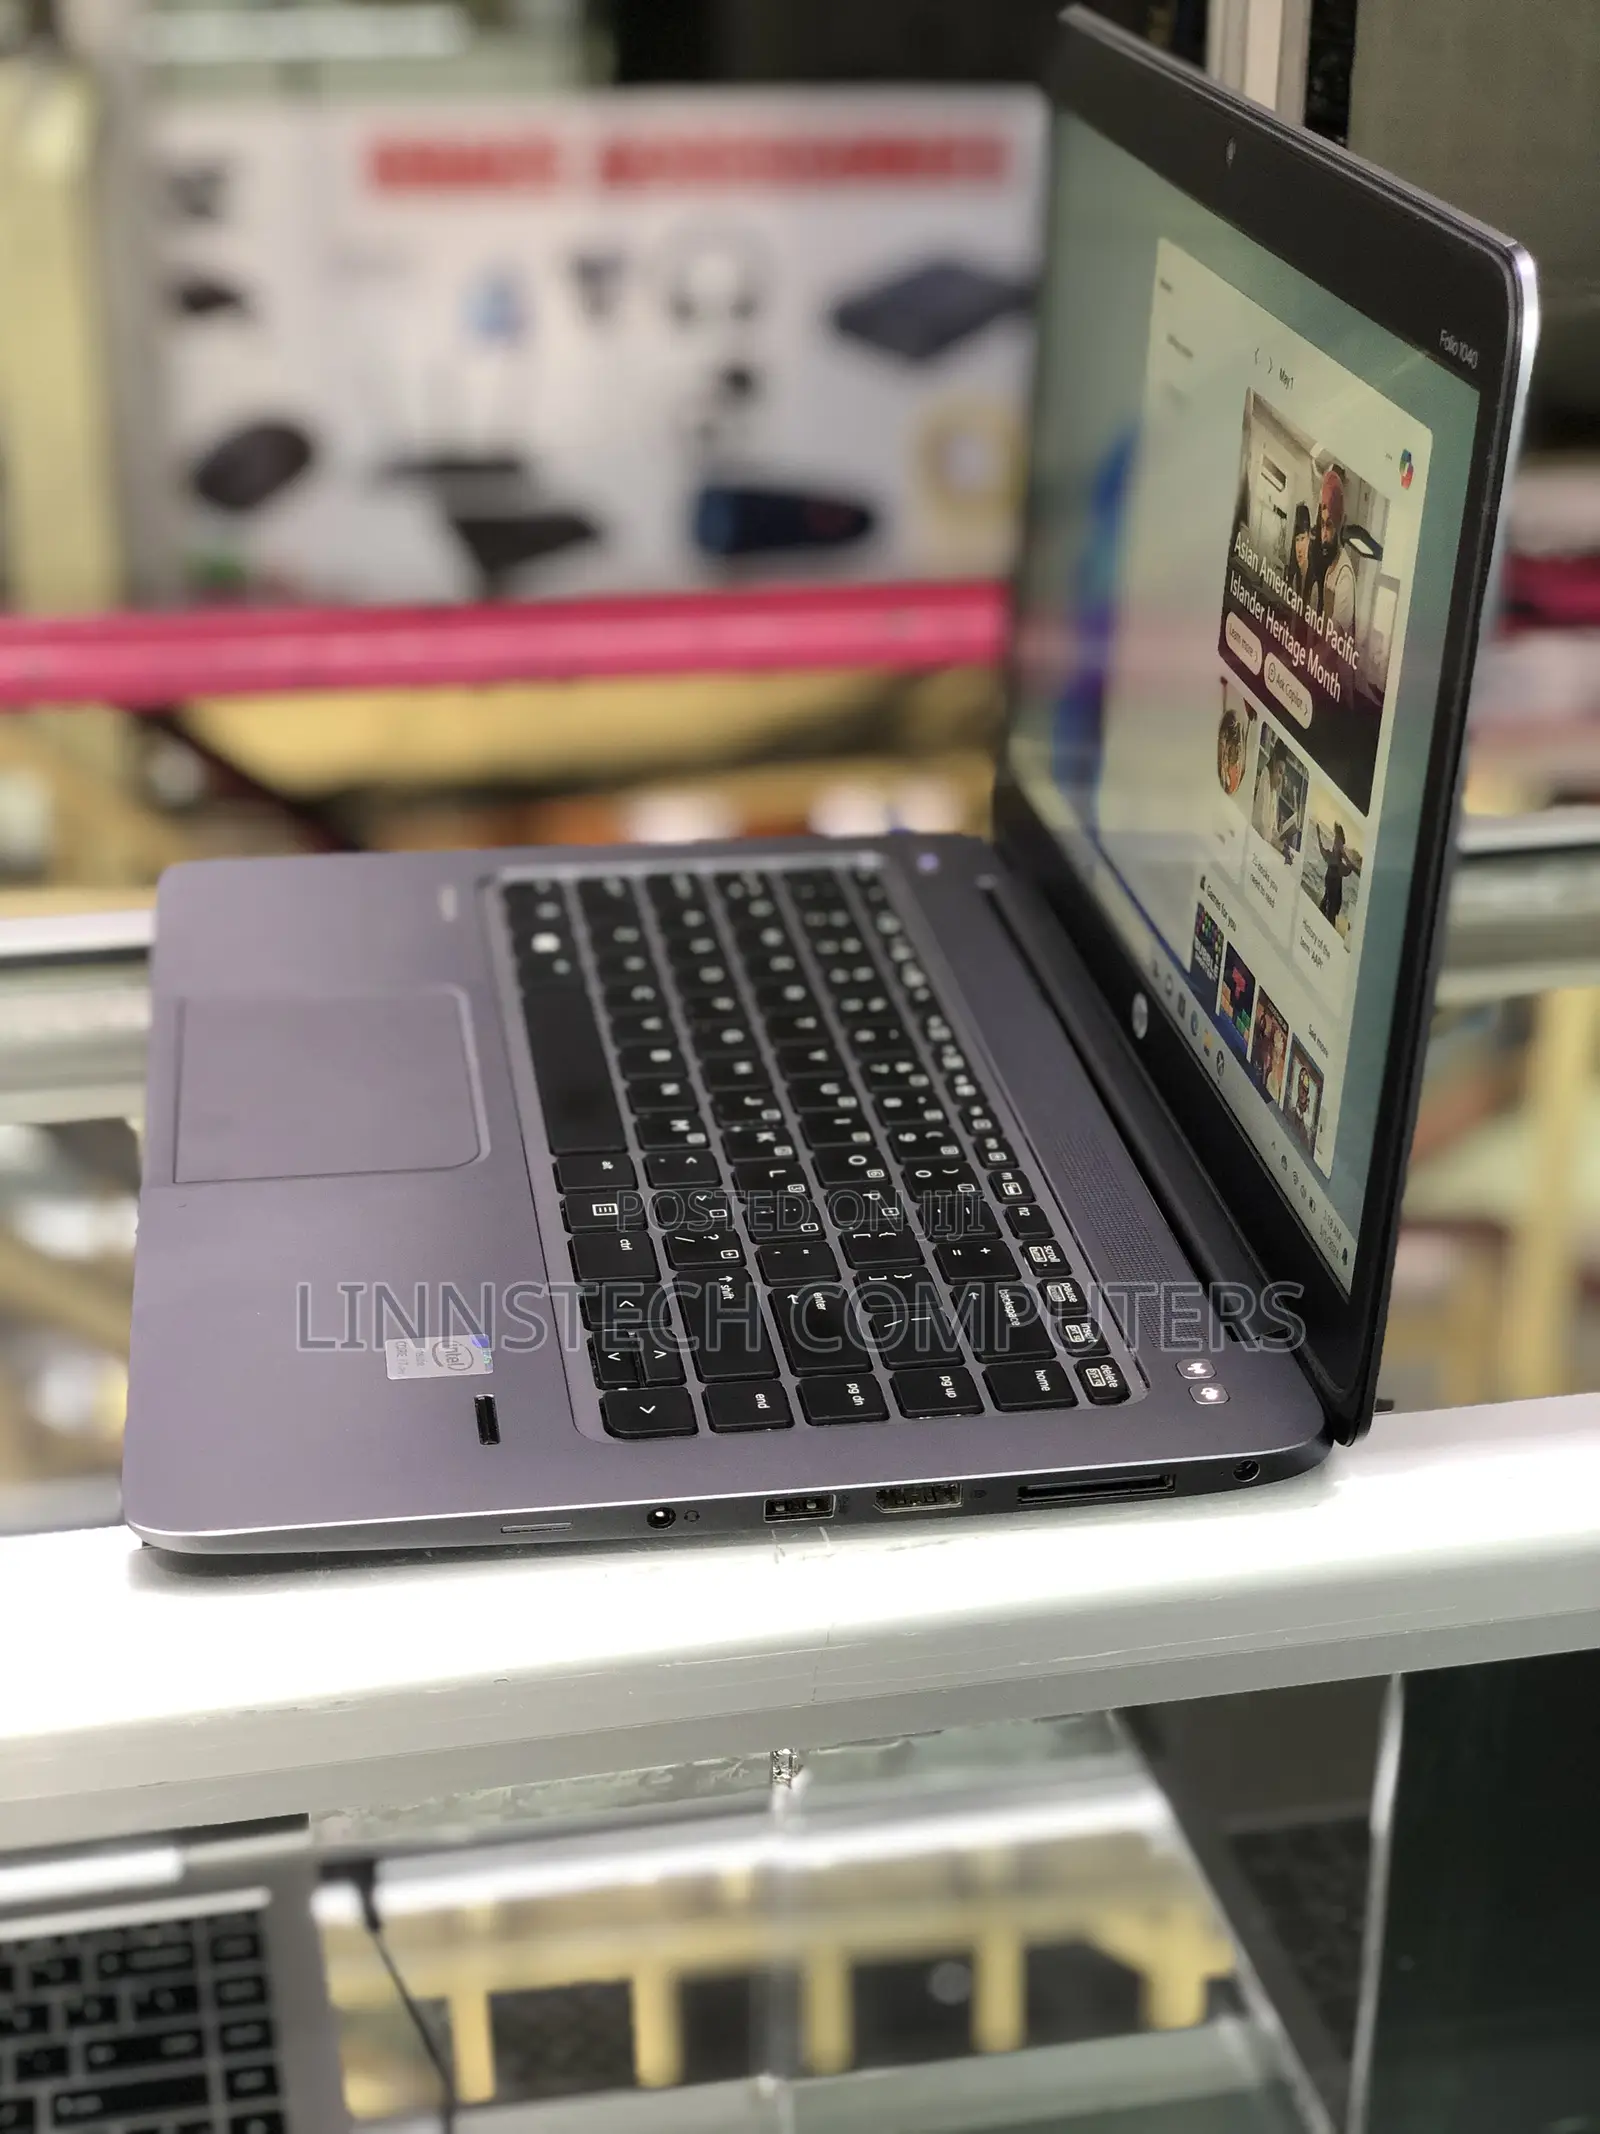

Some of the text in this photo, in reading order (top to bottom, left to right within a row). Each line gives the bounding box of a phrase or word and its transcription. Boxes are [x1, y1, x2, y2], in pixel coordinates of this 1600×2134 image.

[1440, 329, 1479, 370] Folio 1040
[1233, 532, 1360, 671] Asian American and Pacific
[1229, 570, 1342, 703] Islander Heritage Month
[620, 1238, 633, 1251] ctrl
[1044, 1245, 1061, 1263] scroll
[720, 1284, 735, 1300] shift
[813, 1292, 827, 1311] enter
[1060, 1282, 1078, 1303] pause
[998, 1289, 1021, 1326] backspace
[1080, 1322, 1098, 1343] insert
[446, 1342, 464, 1371] intel
[939, 1375, 957, 1399] pg up
[1035, 1369, 1051, 1392] home
[1100, 1364, 1118, 1388] delete
[755, 1393, 770, 1410] end
[847, 1383, 864, 1406] pg dn
